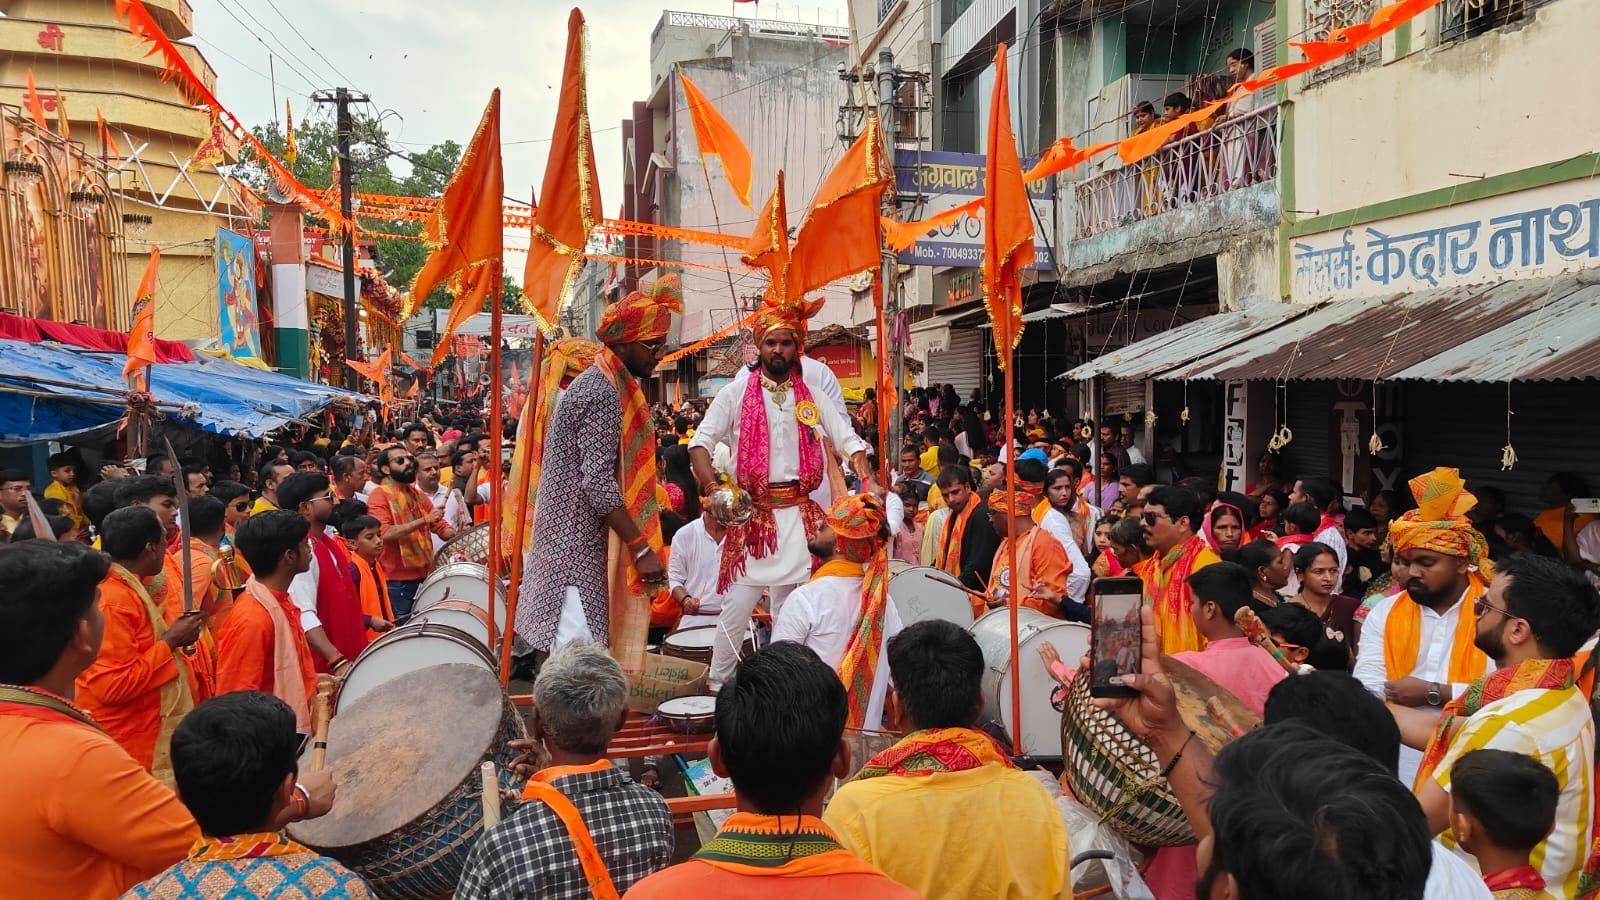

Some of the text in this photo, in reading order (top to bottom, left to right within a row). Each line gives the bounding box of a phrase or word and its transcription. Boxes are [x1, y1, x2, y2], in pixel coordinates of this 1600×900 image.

[37, 22, 65, 51] श्री
[912, 162, 978, 190] अग्रवाल
[942, 247, 983, 261] 70049337
[1365, 220, 1482, 287] केदार
[1488, 198, 1600, 271] नाथ
[629, 683, 677, 699] Bisleri
